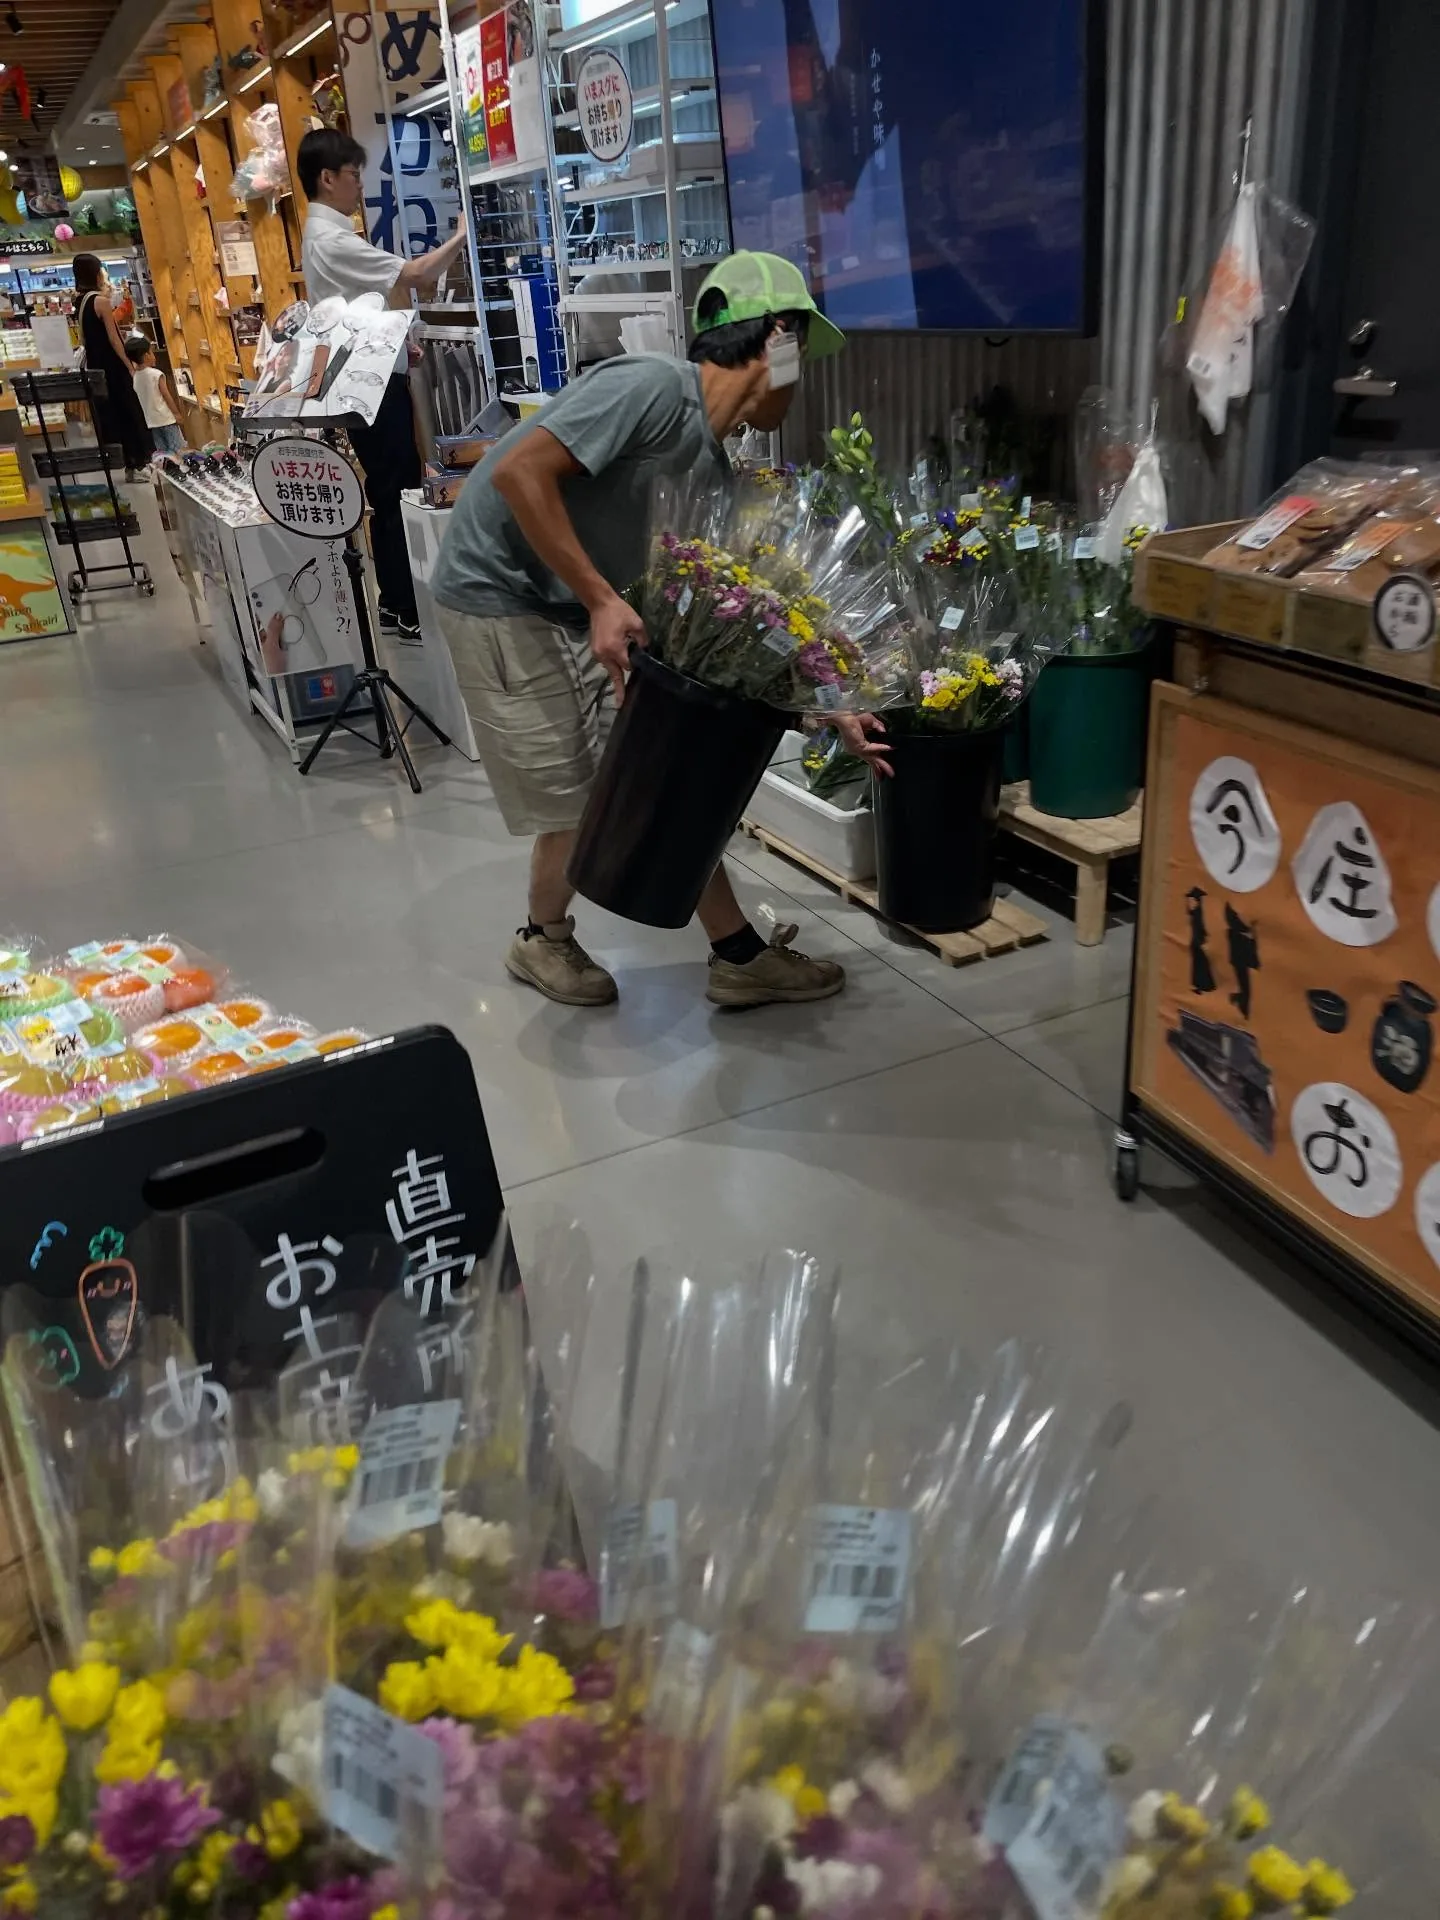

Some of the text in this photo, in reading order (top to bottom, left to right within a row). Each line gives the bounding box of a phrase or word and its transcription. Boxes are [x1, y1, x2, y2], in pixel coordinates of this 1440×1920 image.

[583, 75, 621, 101] いまスグに
[587, 99, 622, 125] お持ちり
[271, 460, 342, 482] いまスグに
[275, 480, 345, 505] お持ち帰り
